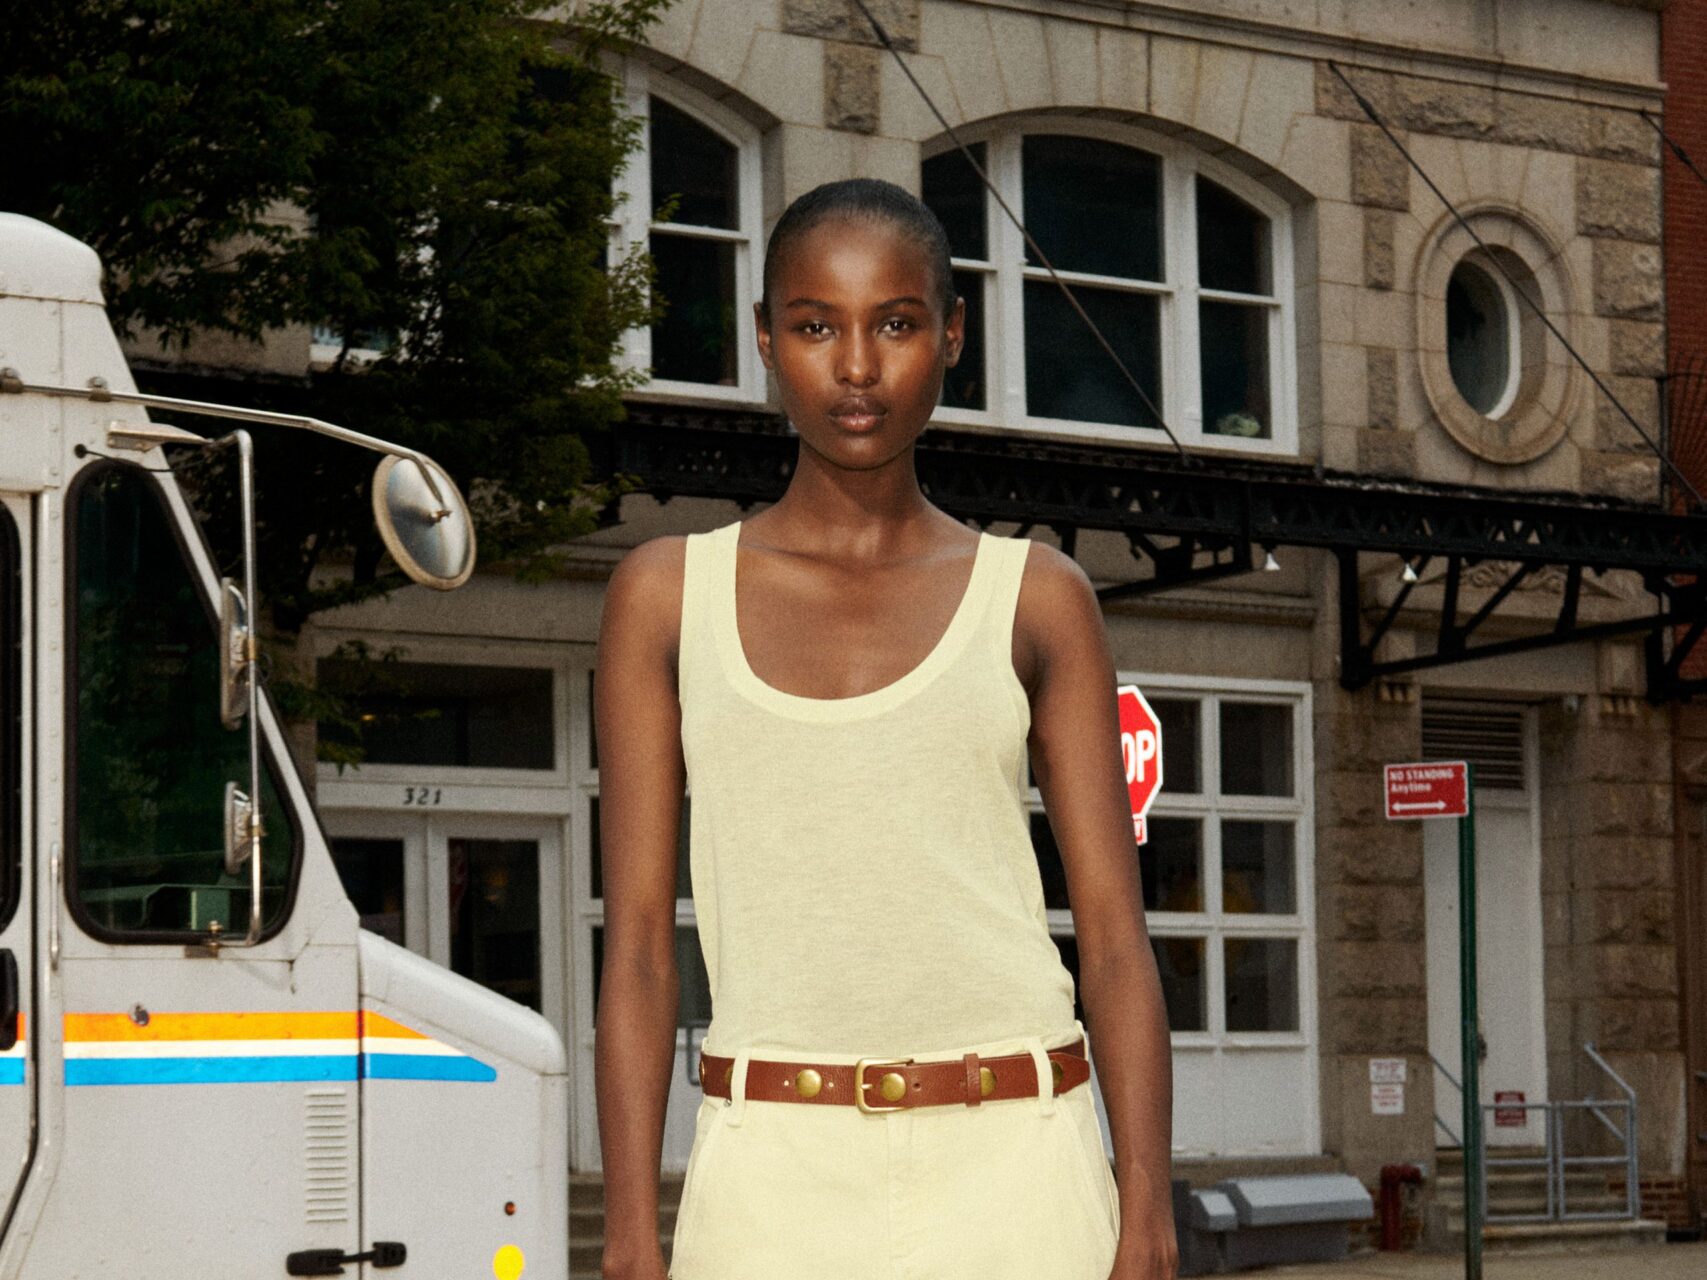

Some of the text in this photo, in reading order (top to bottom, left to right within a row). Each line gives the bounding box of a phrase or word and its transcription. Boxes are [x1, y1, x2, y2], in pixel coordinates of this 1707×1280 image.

[1121, 729, 1156, 784] OP
[1390, 768, 1454, 780] NO STANDING
[1391, 782, 1432, 794] Anytime
[403, 787, 441, 805] 321
